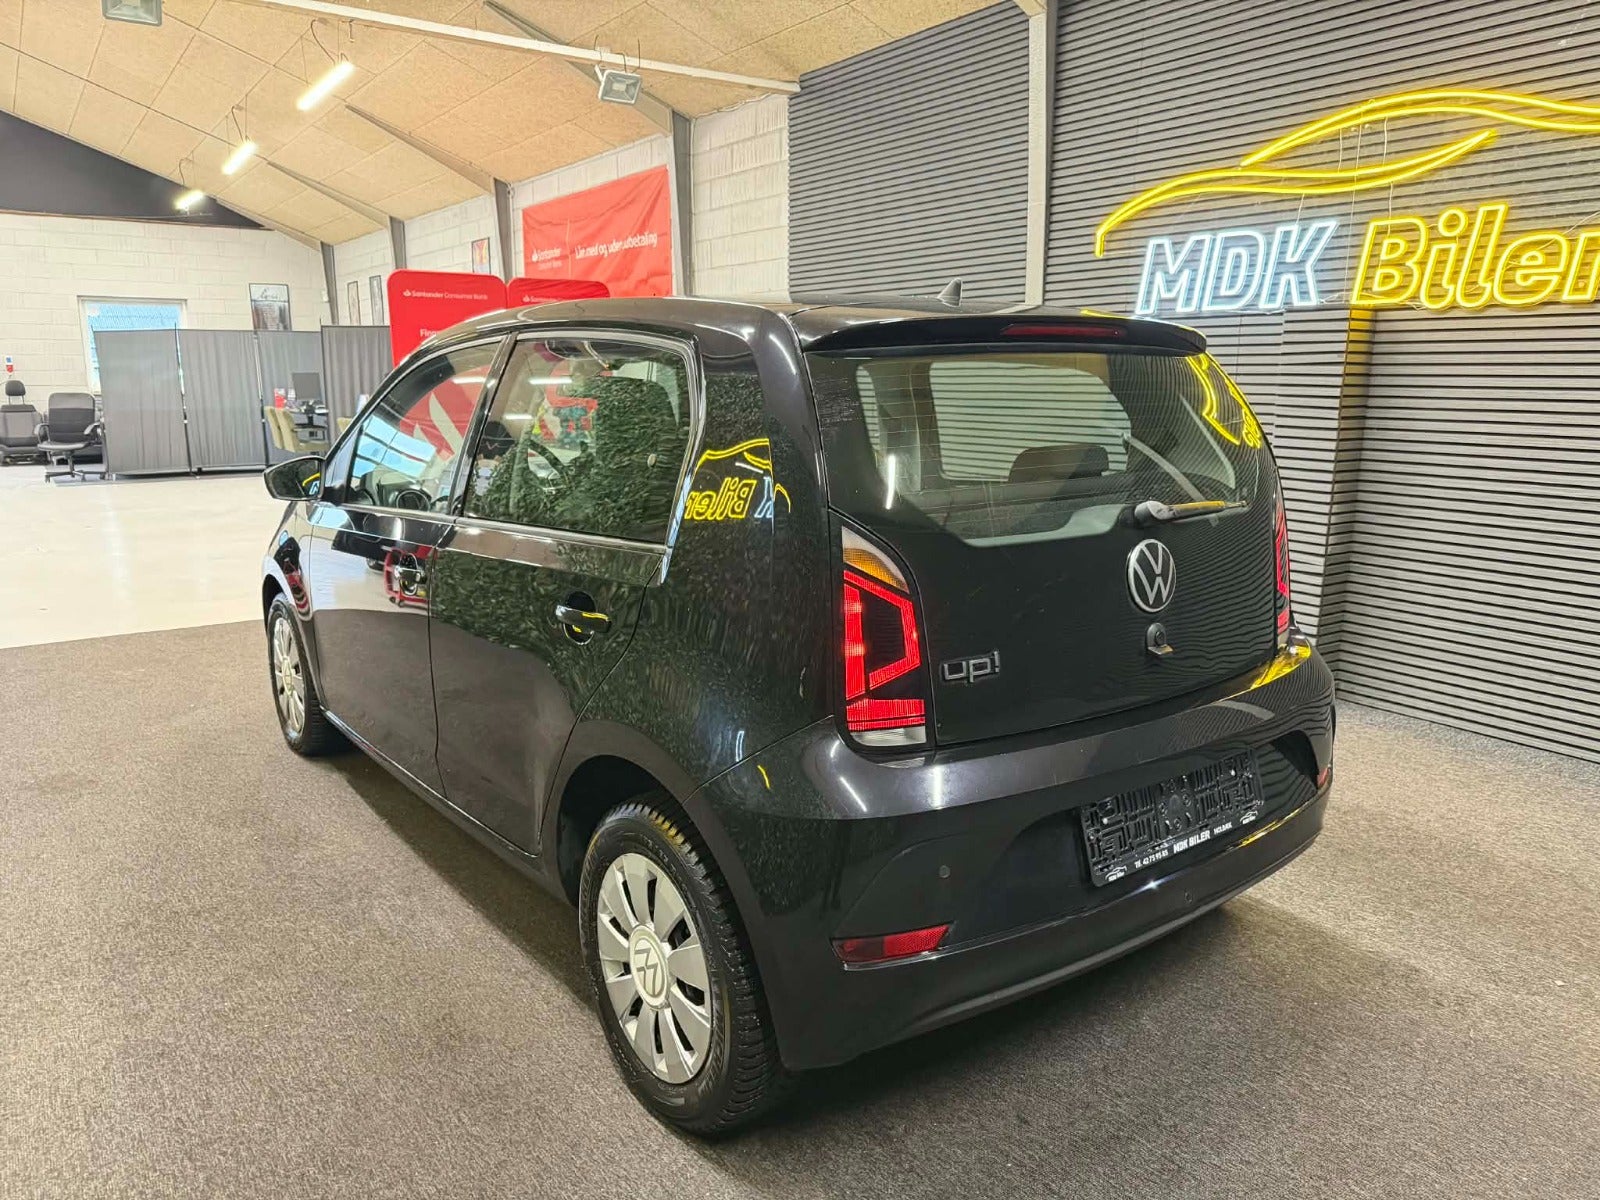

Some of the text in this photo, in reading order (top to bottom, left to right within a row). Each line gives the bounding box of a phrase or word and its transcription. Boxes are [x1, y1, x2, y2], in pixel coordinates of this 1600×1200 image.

[1134, 203, 1600, 316] MDK Biler
[411, 289, 443, 298] Santander
[943, 650, 1001, 683] up!
[1173, 838, 1188, 854] MDK
[1189, 829, 1211, 847] BILER
